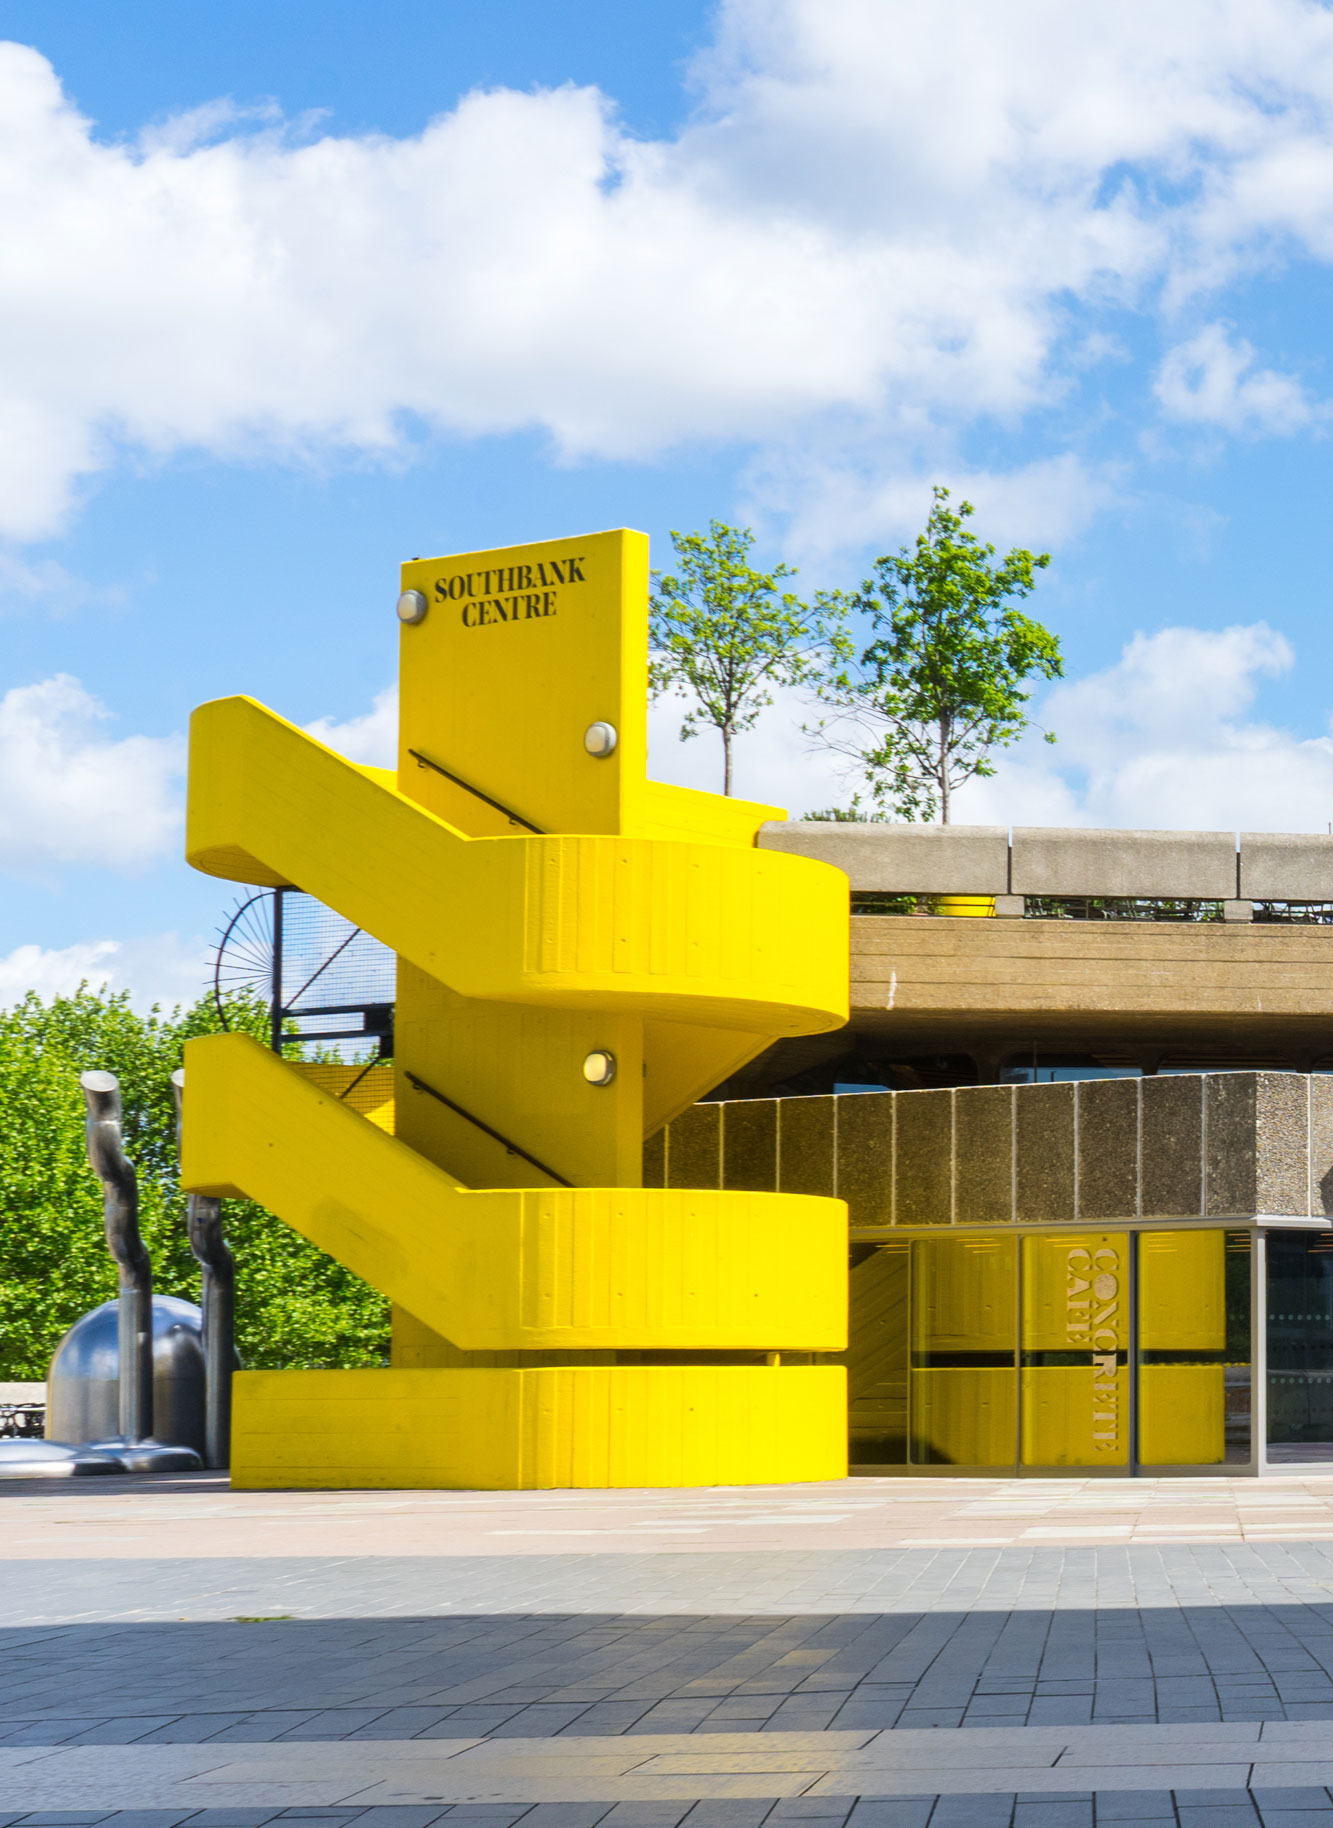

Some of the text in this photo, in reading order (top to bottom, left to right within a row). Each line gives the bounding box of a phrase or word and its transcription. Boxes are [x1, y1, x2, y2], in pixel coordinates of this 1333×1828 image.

[435, 557, 585, 603] SOUTHBANK
[462, 591, 557, 627] CENTRE
[1067, 1248, 1092, 1343] CAFE
[1093, 1248, 1119, 1452] CONCRETE
